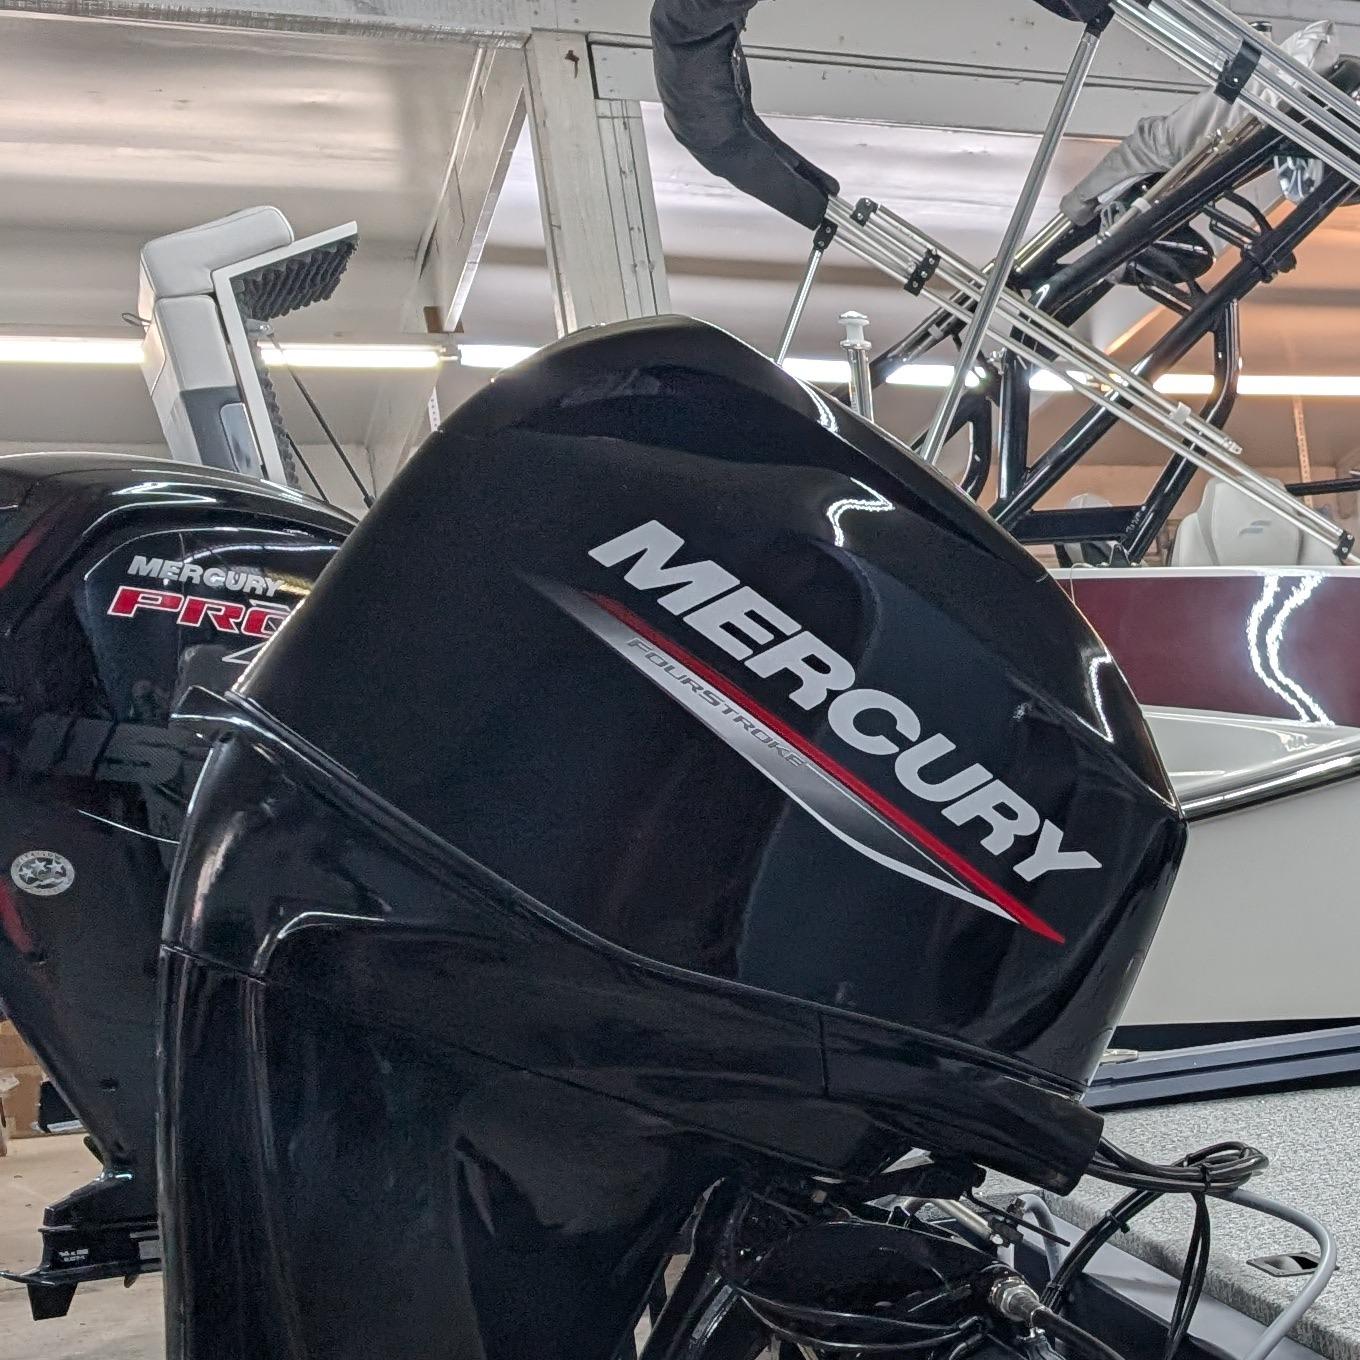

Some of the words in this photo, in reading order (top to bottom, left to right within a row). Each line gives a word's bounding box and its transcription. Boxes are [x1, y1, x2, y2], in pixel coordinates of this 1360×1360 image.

[127, 555, 285, 597] MERCURY
[588, 519, 1102, 882] MERCURY
[626, 636, 805, 768] FOURSTROKE
